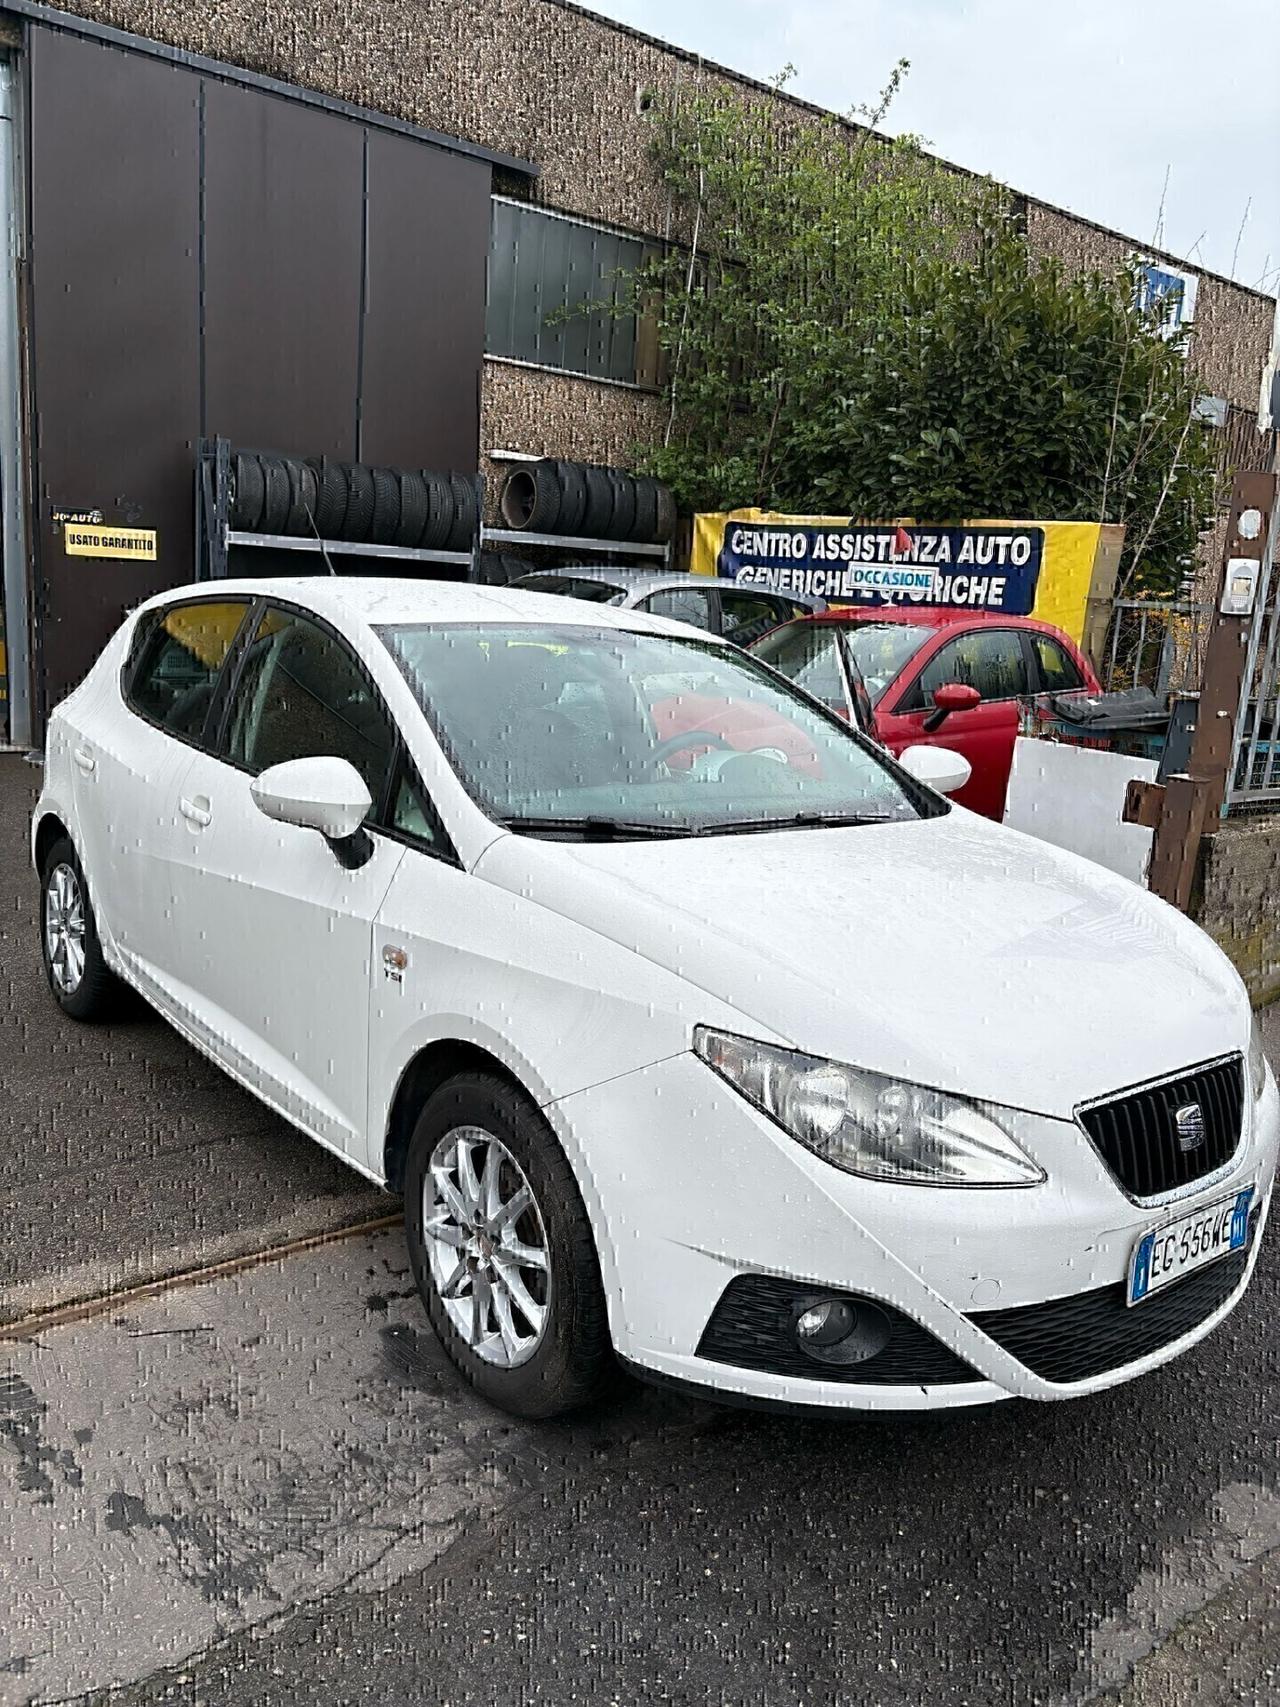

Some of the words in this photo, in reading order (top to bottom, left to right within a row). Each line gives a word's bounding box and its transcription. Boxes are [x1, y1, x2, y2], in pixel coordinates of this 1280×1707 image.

[69, 533, 99, 547] USATO
[102, 536, 153, 551] GARANTITO
[731, 529, 807, 559] CENTRO
[957, 534, 1031, 567] AUTO
[735, 565, 854, 597] GENERICHE
[854, 569, 932, 588] OCCASIONE
[1151, 1235, 1176, 1278] EG
[1179, 1207, 1235, 1264] 556WE
